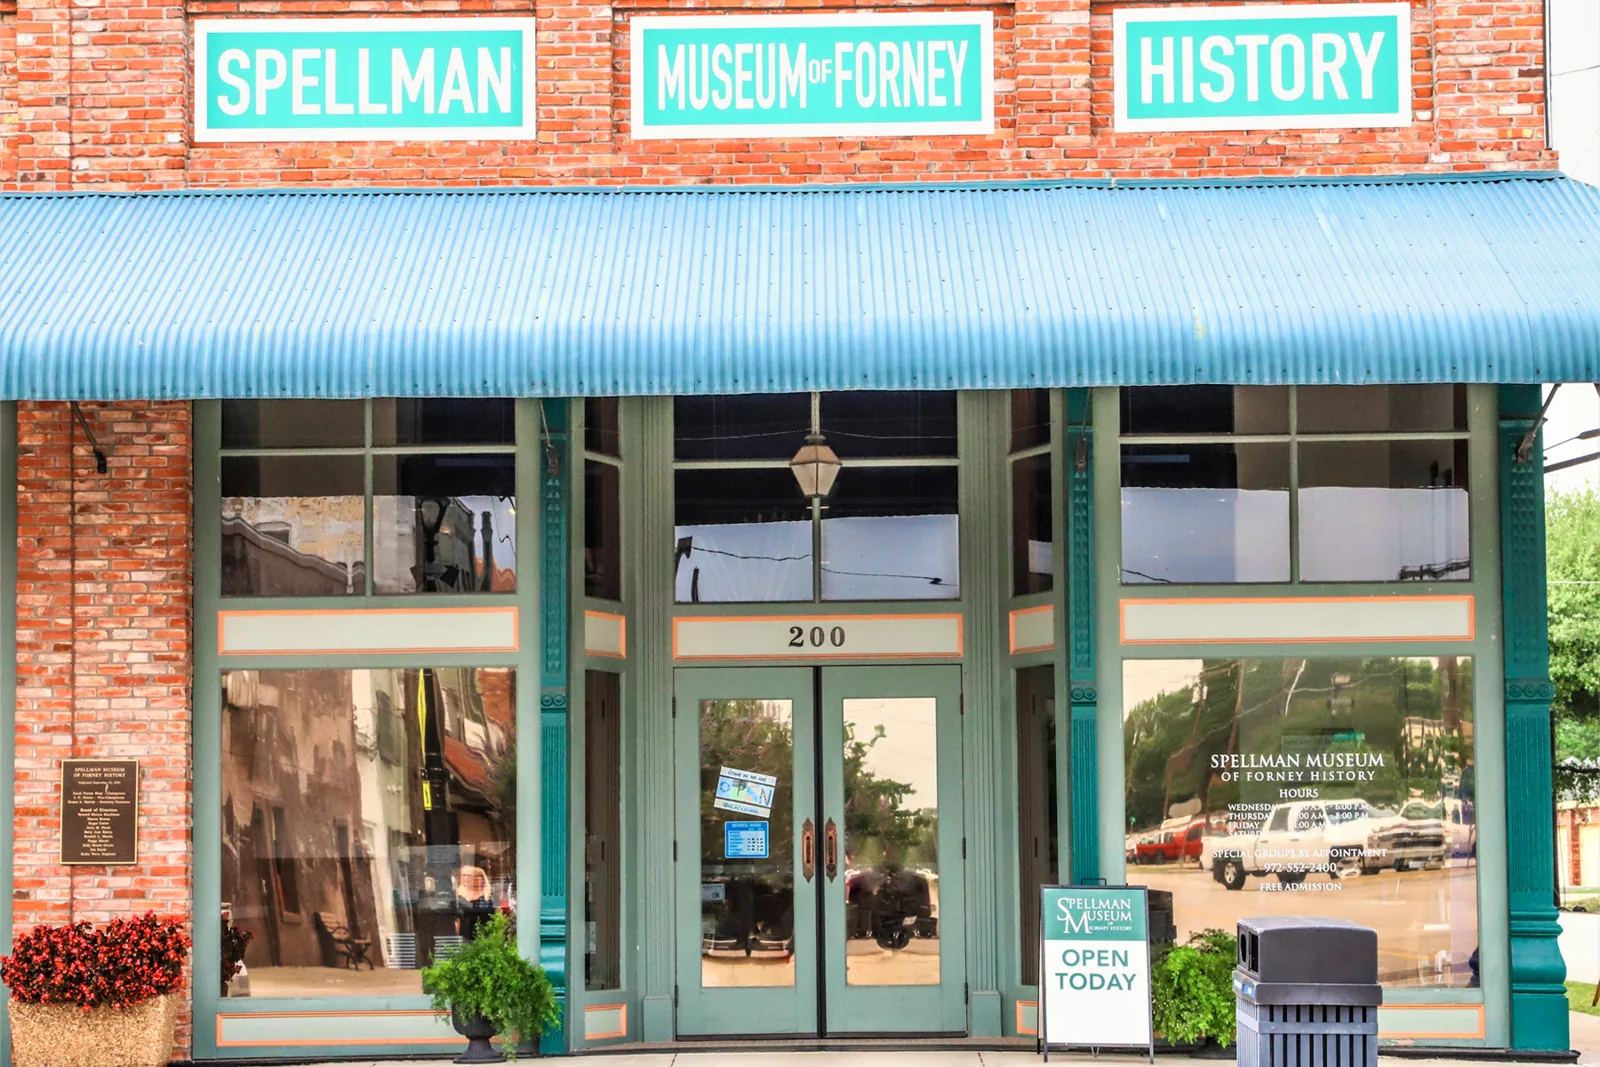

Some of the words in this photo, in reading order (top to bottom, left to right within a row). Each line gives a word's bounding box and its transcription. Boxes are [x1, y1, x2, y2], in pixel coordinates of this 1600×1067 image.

[658, 42, 807, 110] MUSEUM
[808, 59, 832, 84] OF
[835, 40, 968, 109] FORNEY
[1140, 31, 1386, 104] HISTORY
[217, 47, 511, 115] SPELLMAN
[788, 626, 846, 648] 200
[1210, 753, 1300, 769] SPELLMAN
[1306, 752, 1385, 768] MUSEUM
[1221, 771, 1240, 782] OF
[1246, 771, 1303, 782] FORNEY
[1310, 770, 1376, 782] HISTORY
[720, 780, 773, 806] OPN
[1279, 788, 1319, 799] HOURS
[1227, 803, 1281, 811] WEDNESDAY
[1335, 803, 1352, 811] 6:00
[1335, 811, 1352, 820] 8:00
[1228, 821, 1260, 829] FRIDAY
[1212, 849, 1252, 858] SPECIAL
[1254, 848, 1296, 858] GROUPS
[1298, 848, 1310, 858] BY
[1313, 848, 1388, 858] APPOINTMENT
[1264, 862, 1337, 873] 972-552-2400
[1260, 882, 1283, 892] FREE
[1284, 882, 1342, 891] ADMISSION
[1057, 897, 1131, 921] SPELLMAN
[1063, 910, 1132, 934] MUSEUM
[1062, 949, 1129, 967] OPEN
[1055, 972, 1136, 990] TODAY
